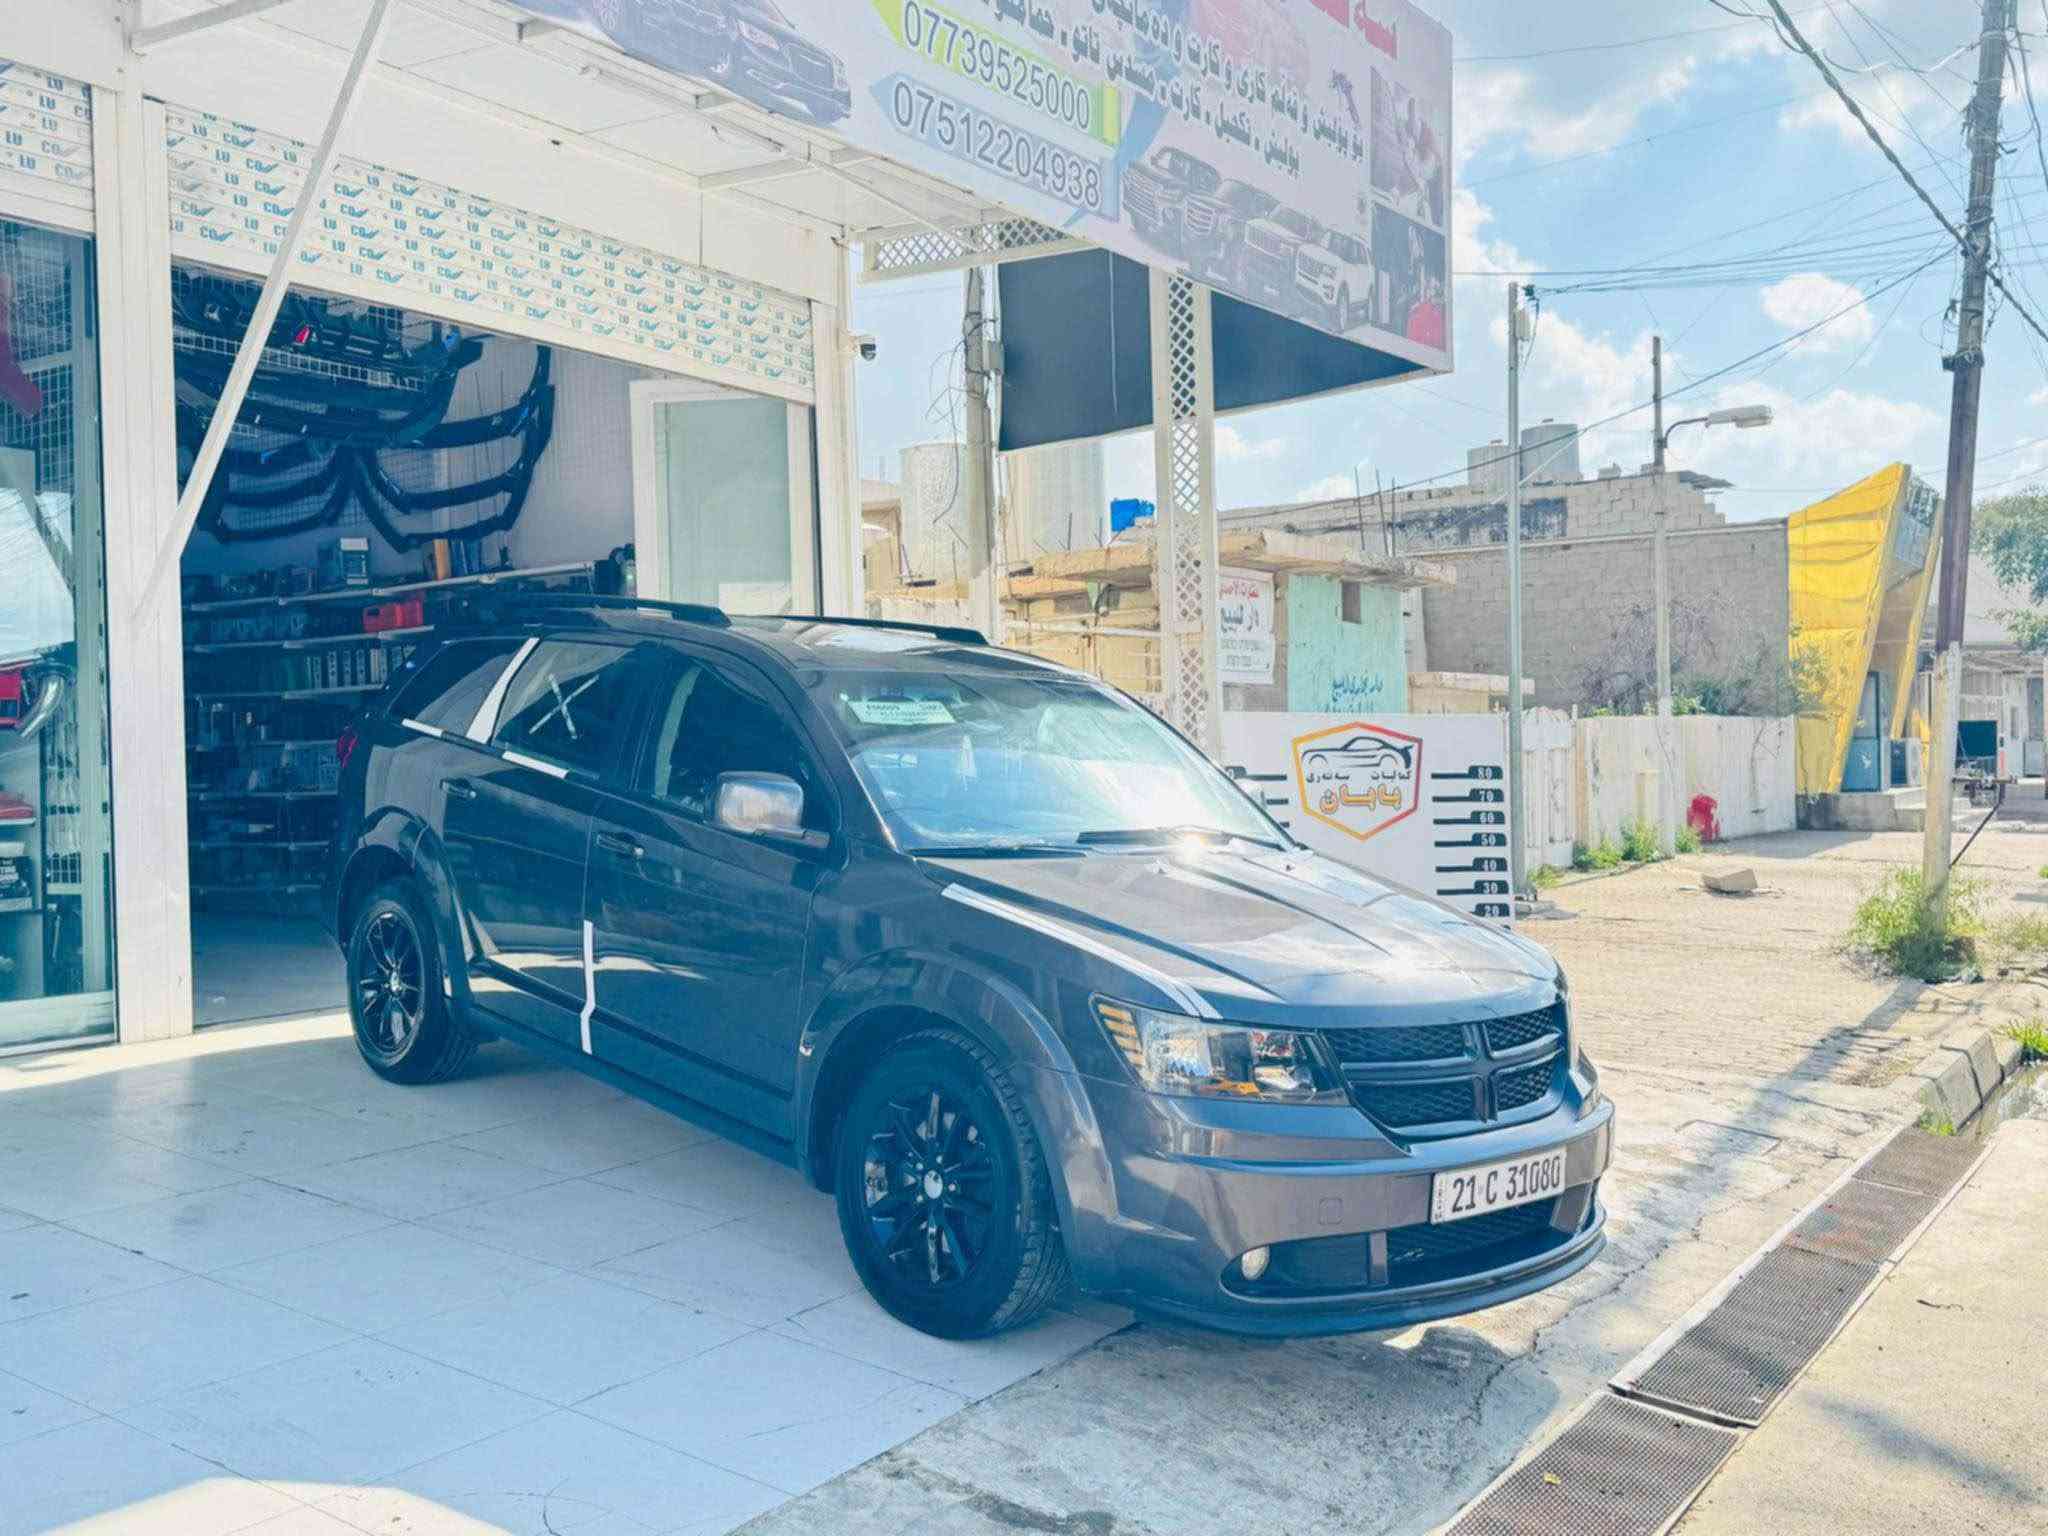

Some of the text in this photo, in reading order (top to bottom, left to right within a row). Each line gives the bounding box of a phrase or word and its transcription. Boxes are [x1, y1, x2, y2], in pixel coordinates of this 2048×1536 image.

[904, 1, 1090, 130] 07739525000
[894, 81, 1099, 208] 07512204938
[1477, 767, 1493, 780] 80
[1479, 790, 1494, 802] 70
[1480, 833, 1496, 846] 50
[1482, 859, 1498, 871] 40
[1482, 882, 1498, 894] 30
[1451, 1174, 1476, 1213] 21
[1486, 1170, 1499, 1205] C
[1506, 1155, 1561, 1201] 31080
